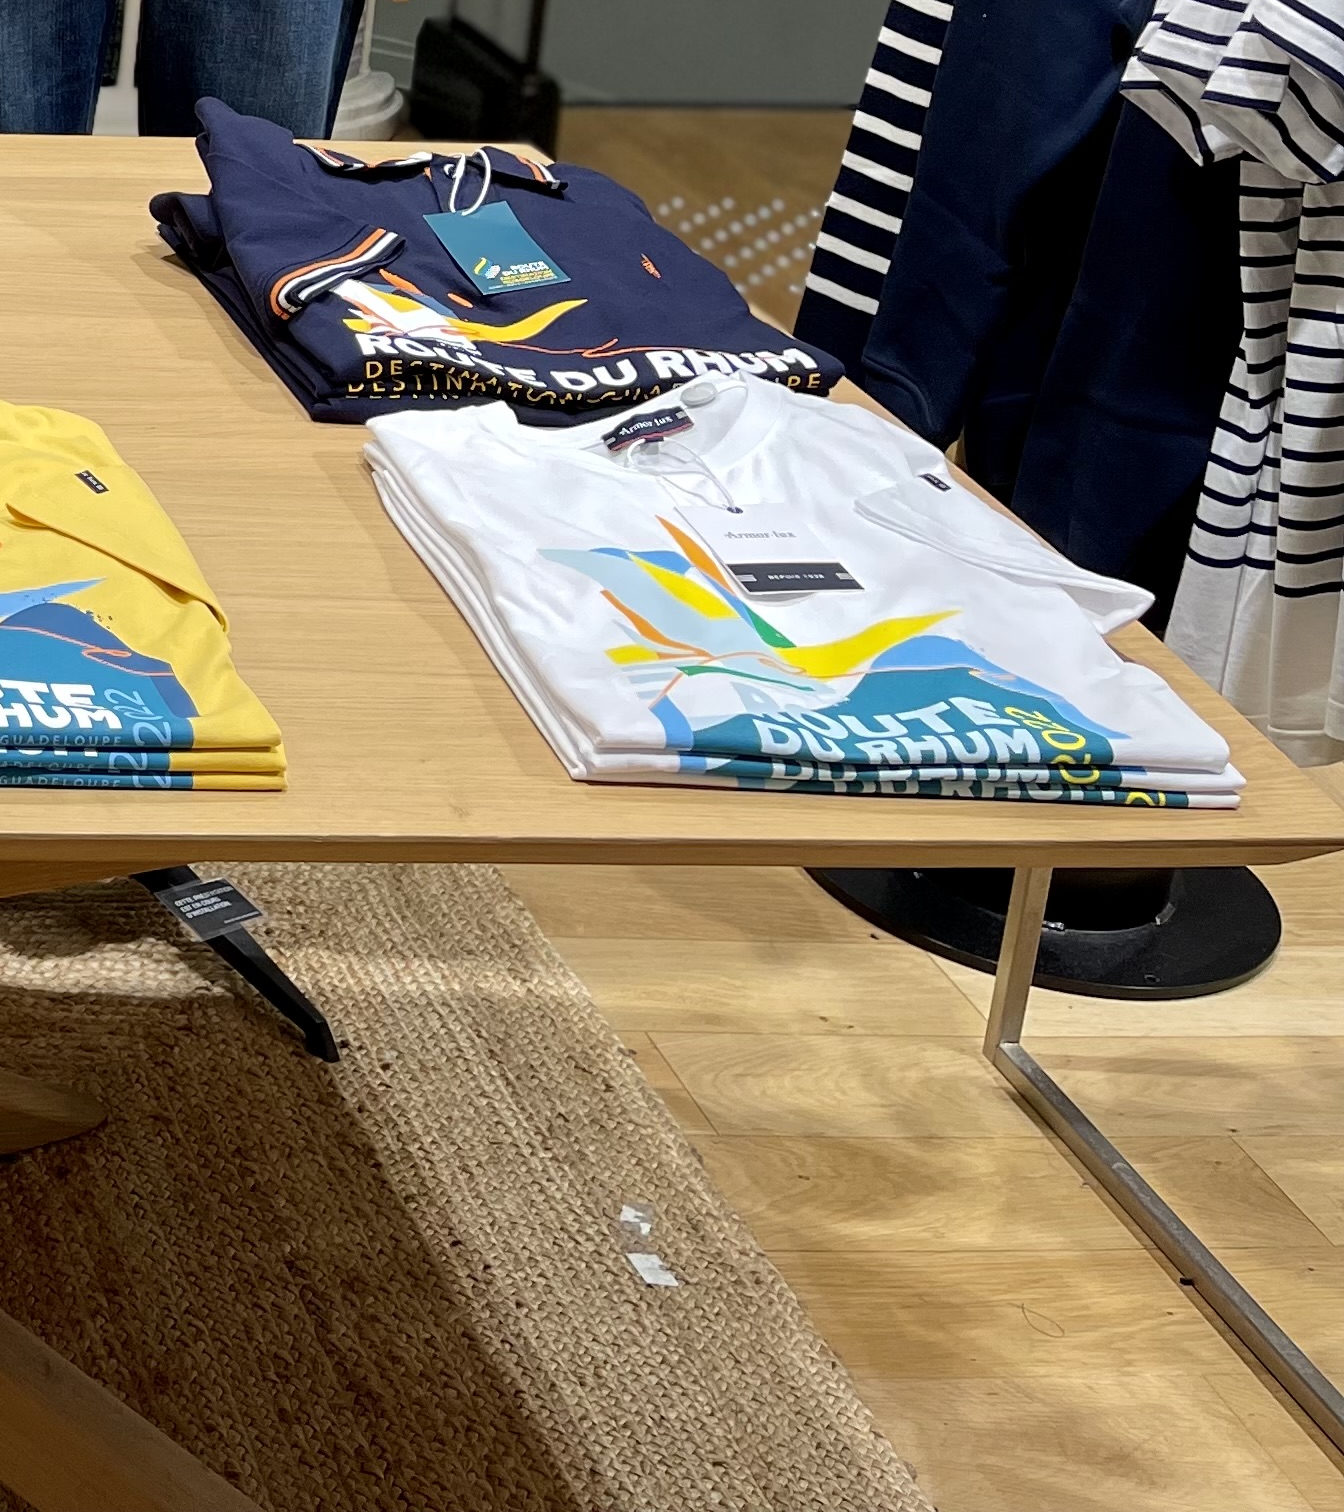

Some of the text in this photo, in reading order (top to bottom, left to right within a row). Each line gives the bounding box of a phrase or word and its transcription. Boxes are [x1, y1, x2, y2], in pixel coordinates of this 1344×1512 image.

[355, 333, 547, 388] ROUTE
[550, 358, 637, 392] DU
[645, 347, 818, 379] RHUM
[730, 681, 1021, 740] ROUTE
[0, 734, 122, 746] GUADELOUPE
[752, 718, 1041, 765] DU RHUM
